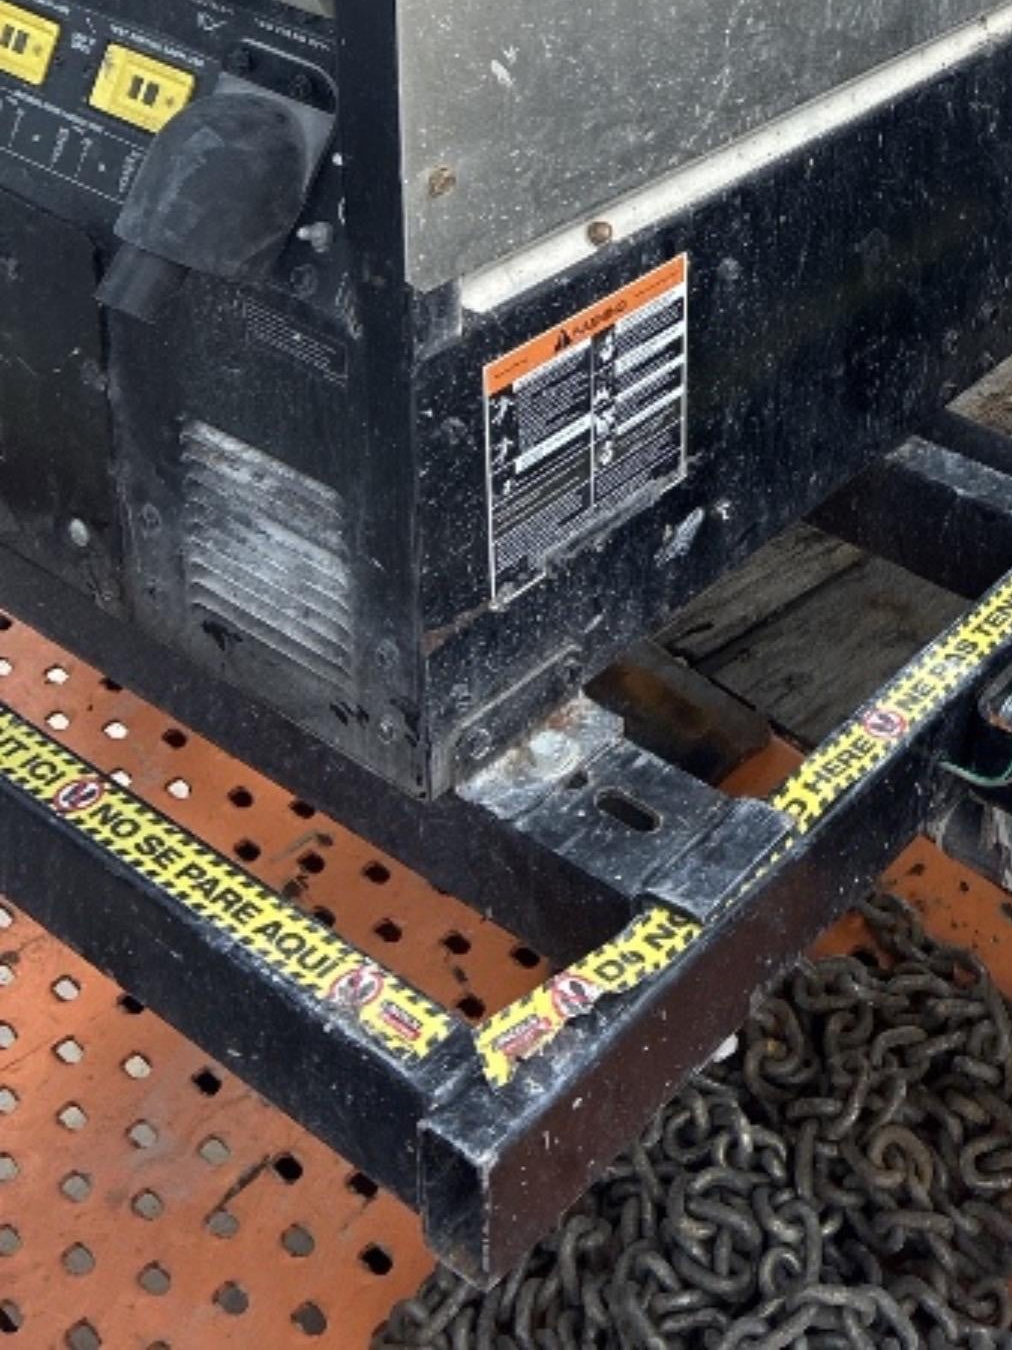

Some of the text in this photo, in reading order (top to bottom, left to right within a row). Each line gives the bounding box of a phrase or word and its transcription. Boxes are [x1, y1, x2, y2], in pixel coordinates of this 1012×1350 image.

[17, 752, 67, 787] ICI
[802, 735, 876, 796] HERE
[88, 802, 142, 839] NO
[134, 834, 185, 871] SE
[174, 861, 264, 925] PARE
